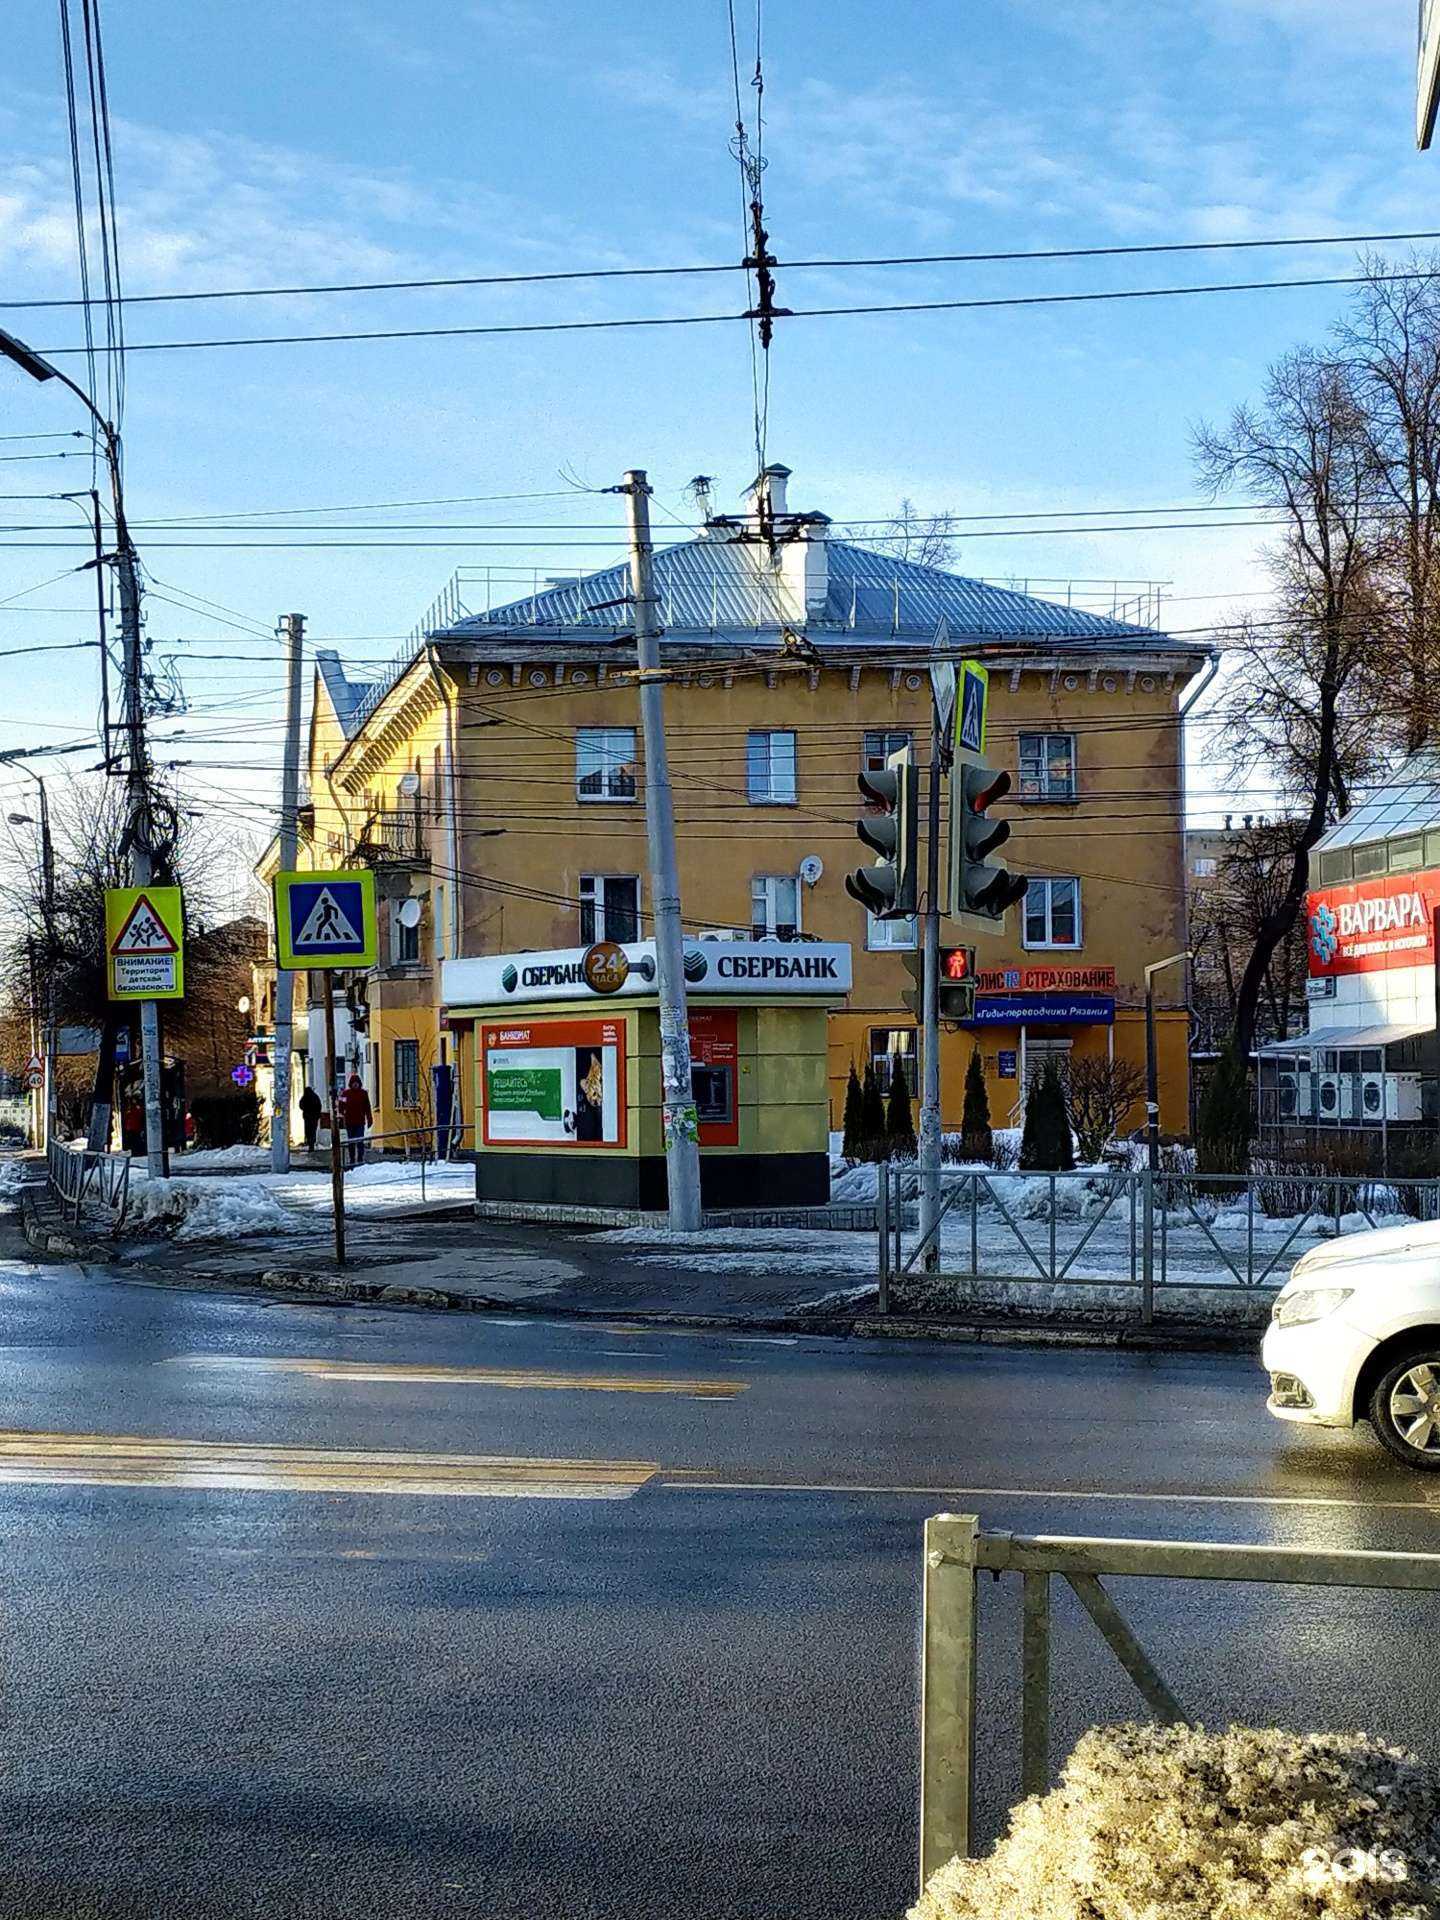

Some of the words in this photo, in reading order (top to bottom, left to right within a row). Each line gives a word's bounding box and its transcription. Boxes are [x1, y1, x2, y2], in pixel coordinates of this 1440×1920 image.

[1340, 891, 1427, 936] ВАРВАРА
[117, 957, 173, 966] ВНИМАНИЕ!
[591, 953, 618, 973] 24
[717, 956, 838, 979] СБЕРБАНК
[522, 963, 585, 987] СБЕРБАН
[594, 974, 619, 983] ЧАСА
[1025, 971, 1114, 988] СТРАХОВАНИЕ
